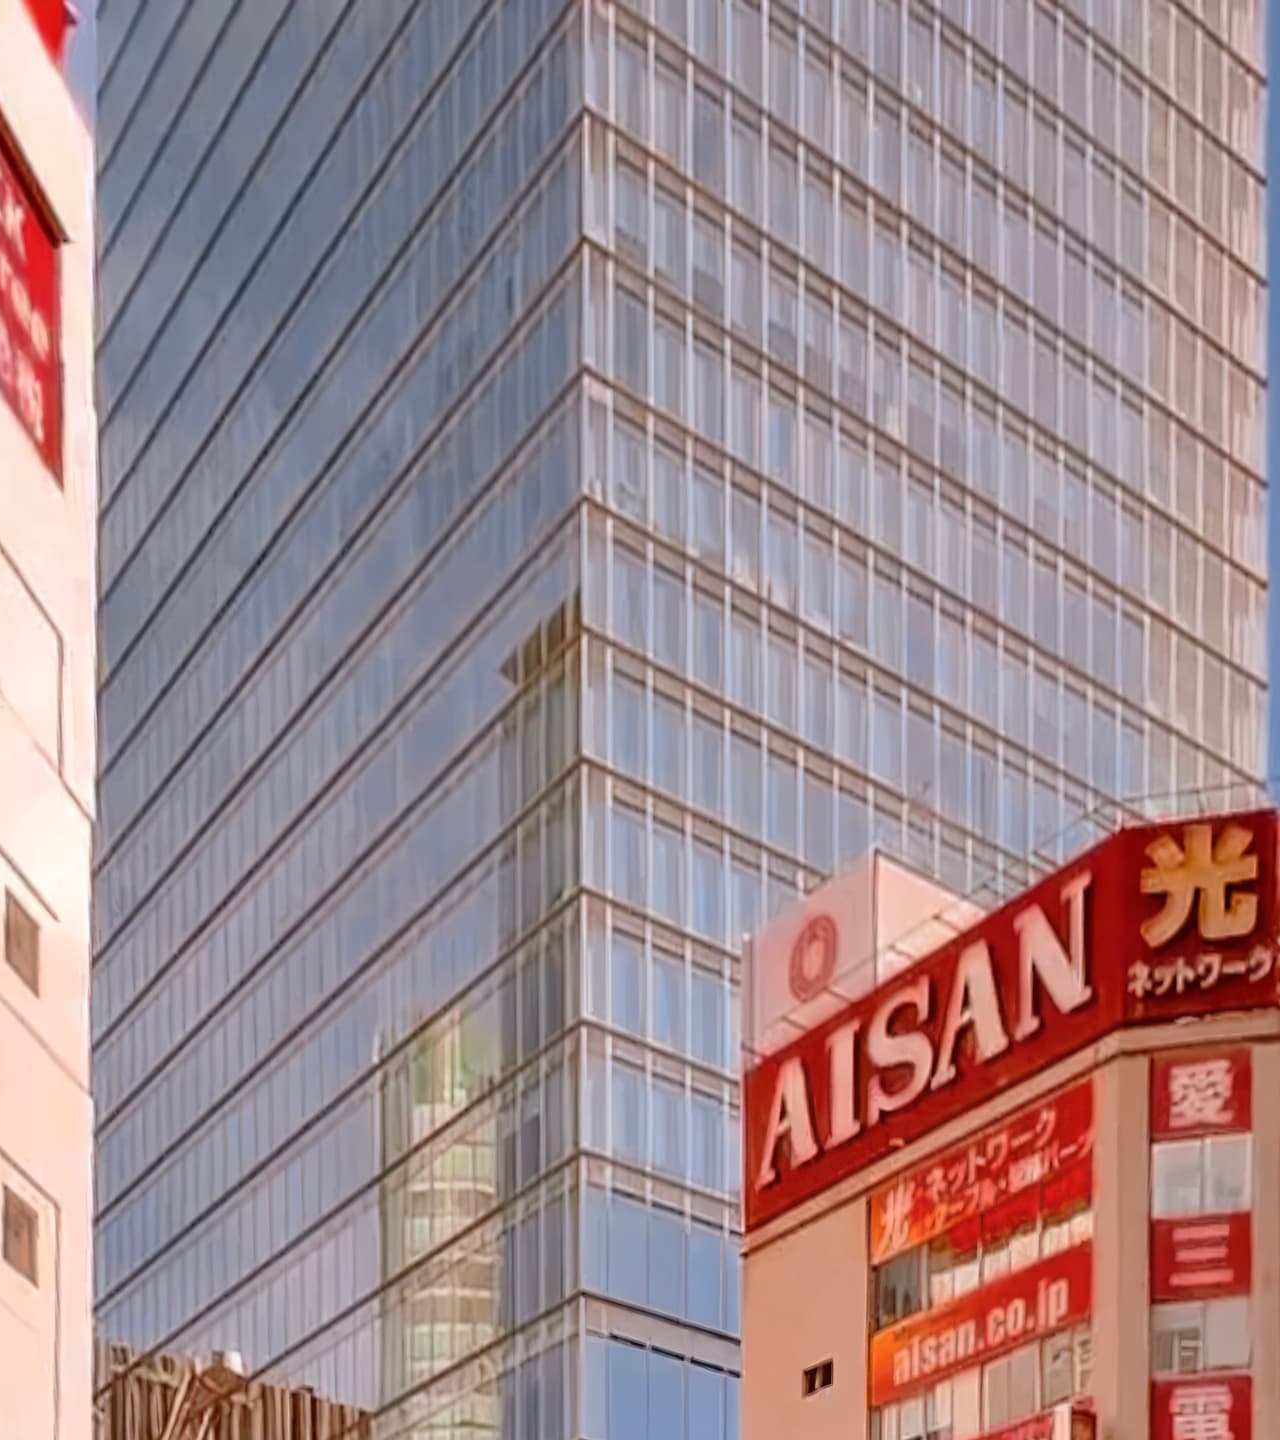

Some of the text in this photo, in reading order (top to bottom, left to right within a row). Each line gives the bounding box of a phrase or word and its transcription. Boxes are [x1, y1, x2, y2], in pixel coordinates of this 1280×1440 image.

[1140, 823, 1259, 950] 光
[754, 870, 1096, 1192] AISAN
[1127, 943, 1273, 998] ネットワーク
